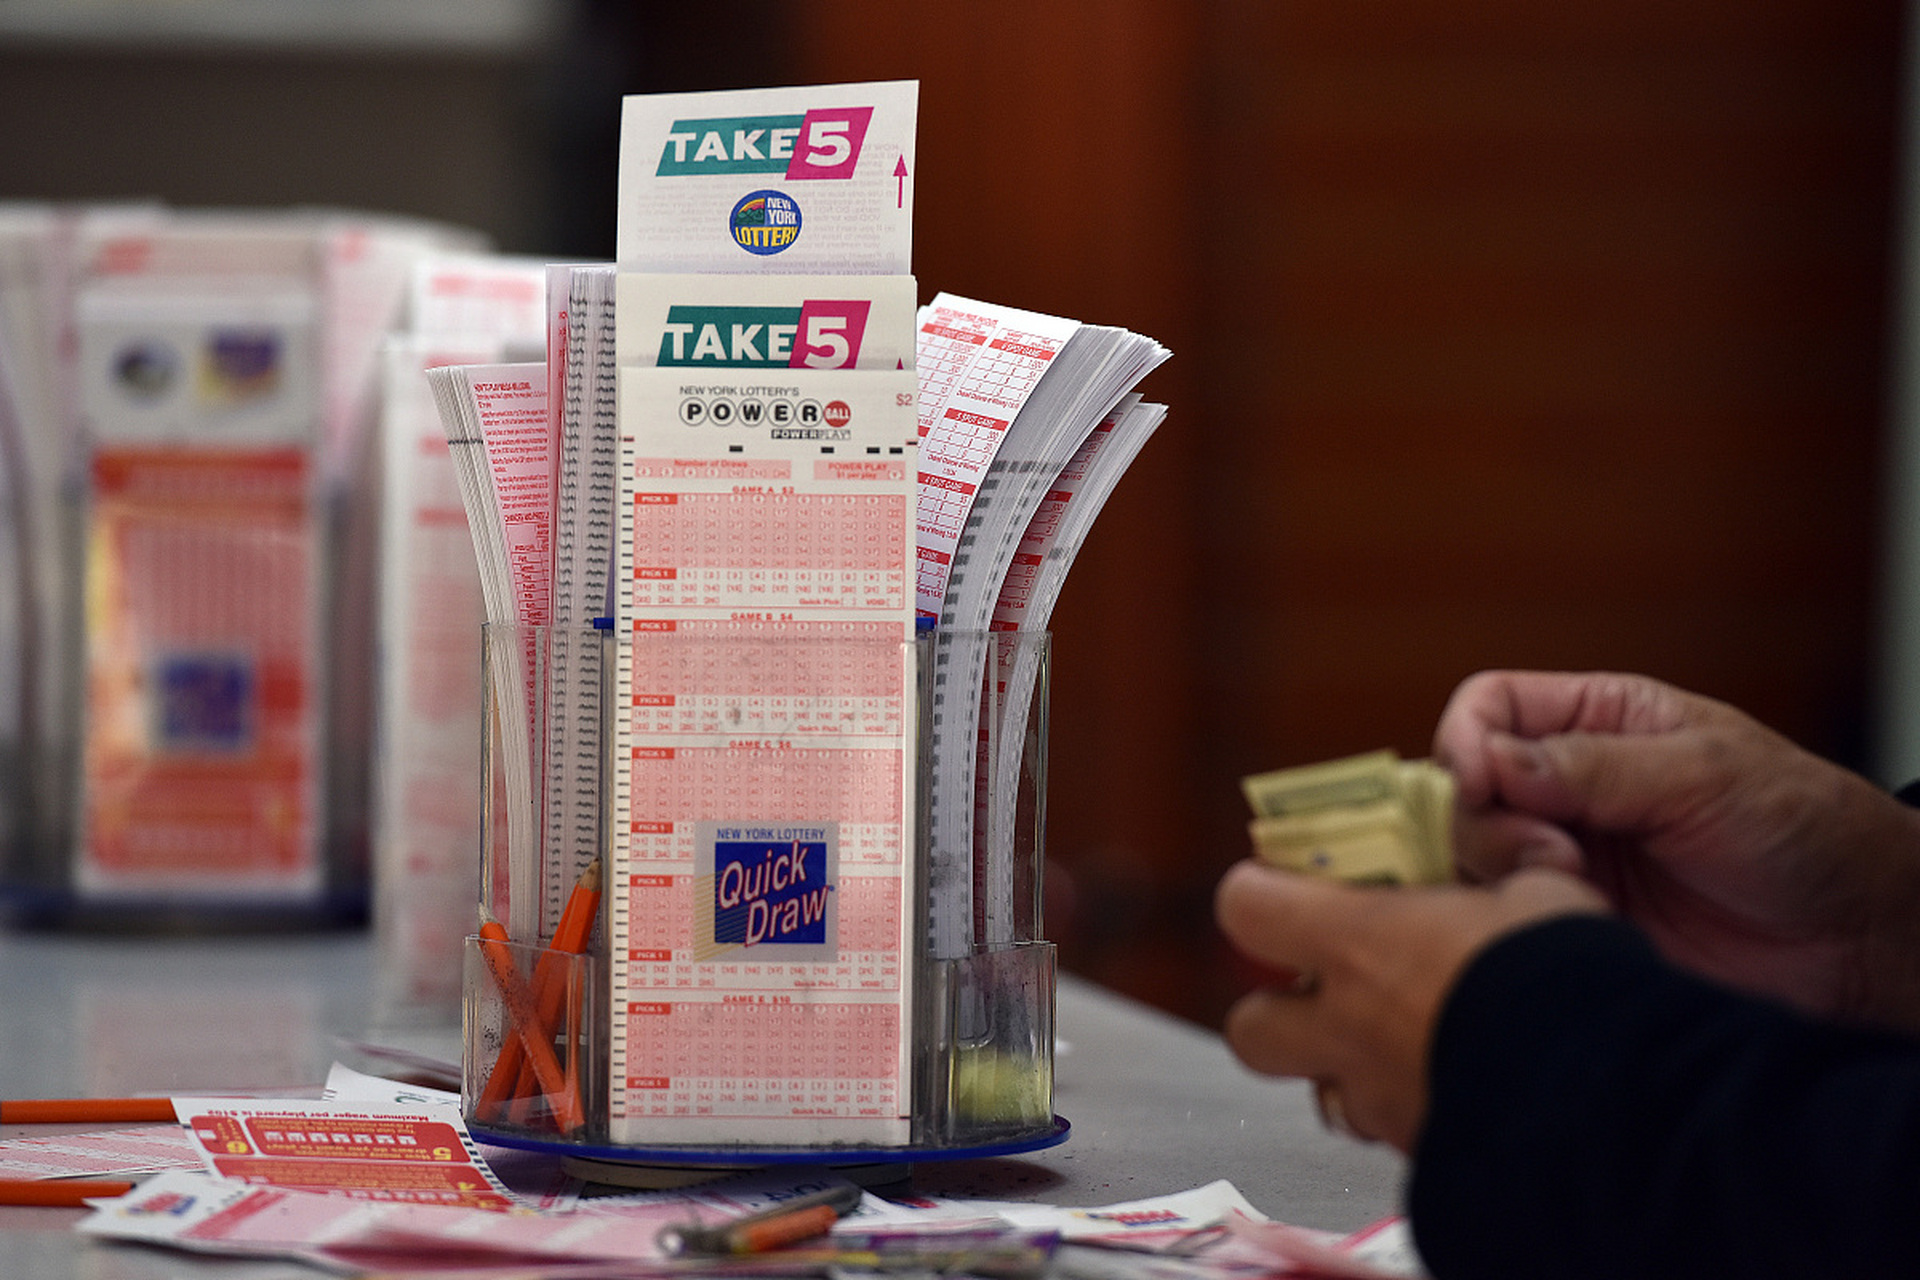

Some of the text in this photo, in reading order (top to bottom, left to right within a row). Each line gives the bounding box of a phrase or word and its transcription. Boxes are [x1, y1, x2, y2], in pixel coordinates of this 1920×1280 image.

[667, 120, 851, 166] TAKE 5
[767, 197, 791, 210] NEW
[735, 226, 799, 247] LOTTERY
[664, 316, 850, 370] TAKE 5
[680, 386, 800, 396] NEW YORK LOTTERY'S
[895, 394, 913, 406] $2
[733, 486, 762, 494] GAME
[731, 612, 762, 620] GAME
[730, 740, 760, 748] GAME
[717, 828, 825, 840] NEW YORK LOTTERY
[719, 839, 809, 909] Quick
[744, 885, 829, 948] Draw
[372, 1112, 428, 1122] Maximum
[433, 1147, 452, 1160] 5
